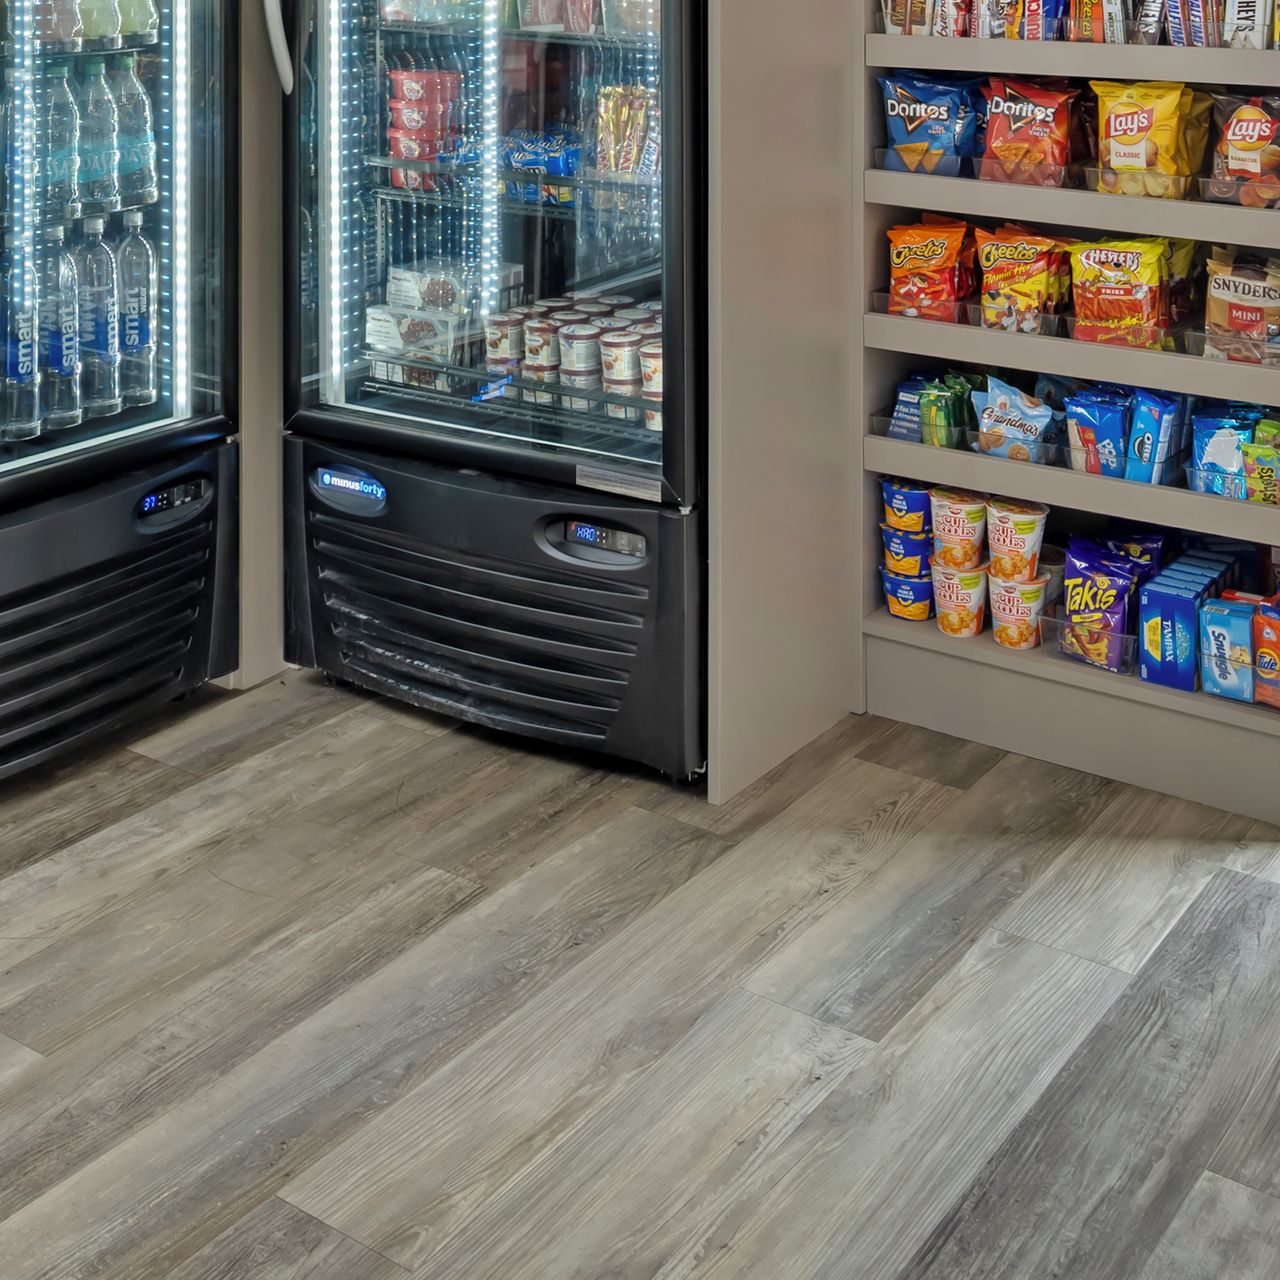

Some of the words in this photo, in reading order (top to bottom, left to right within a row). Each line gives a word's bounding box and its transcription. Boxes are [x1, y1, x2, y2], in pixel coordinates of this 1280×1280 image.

[887, 99, 949, 121] Doritos
[991, 96, 1057, 122] Doritos
[1110, 111, 1149, 136] Lay's
[1227, 119, 1271, 142] Lay's
[1115, 151, 1141, 160] CLASSIC
[892, 240, 946, 266] Cheetos
[981, 243, 1038, 268] Cheetos
[1101, 288, 1125, 296] FRIES
[125, 287, 139, 346] smart
[1232, 309, 1261, 320] MINI
[16, 311, 32, 374] smart
[58, 305, 75, 367] smart
[981, 406, 1039, 436] Grandma's
[331, 476, 383, 497] minusforty
[1064, 577, 1117, 614] Takis
[1162, 620, 1174, 662] TAMPAX
[1257, 654, 1278, 669] Tide
